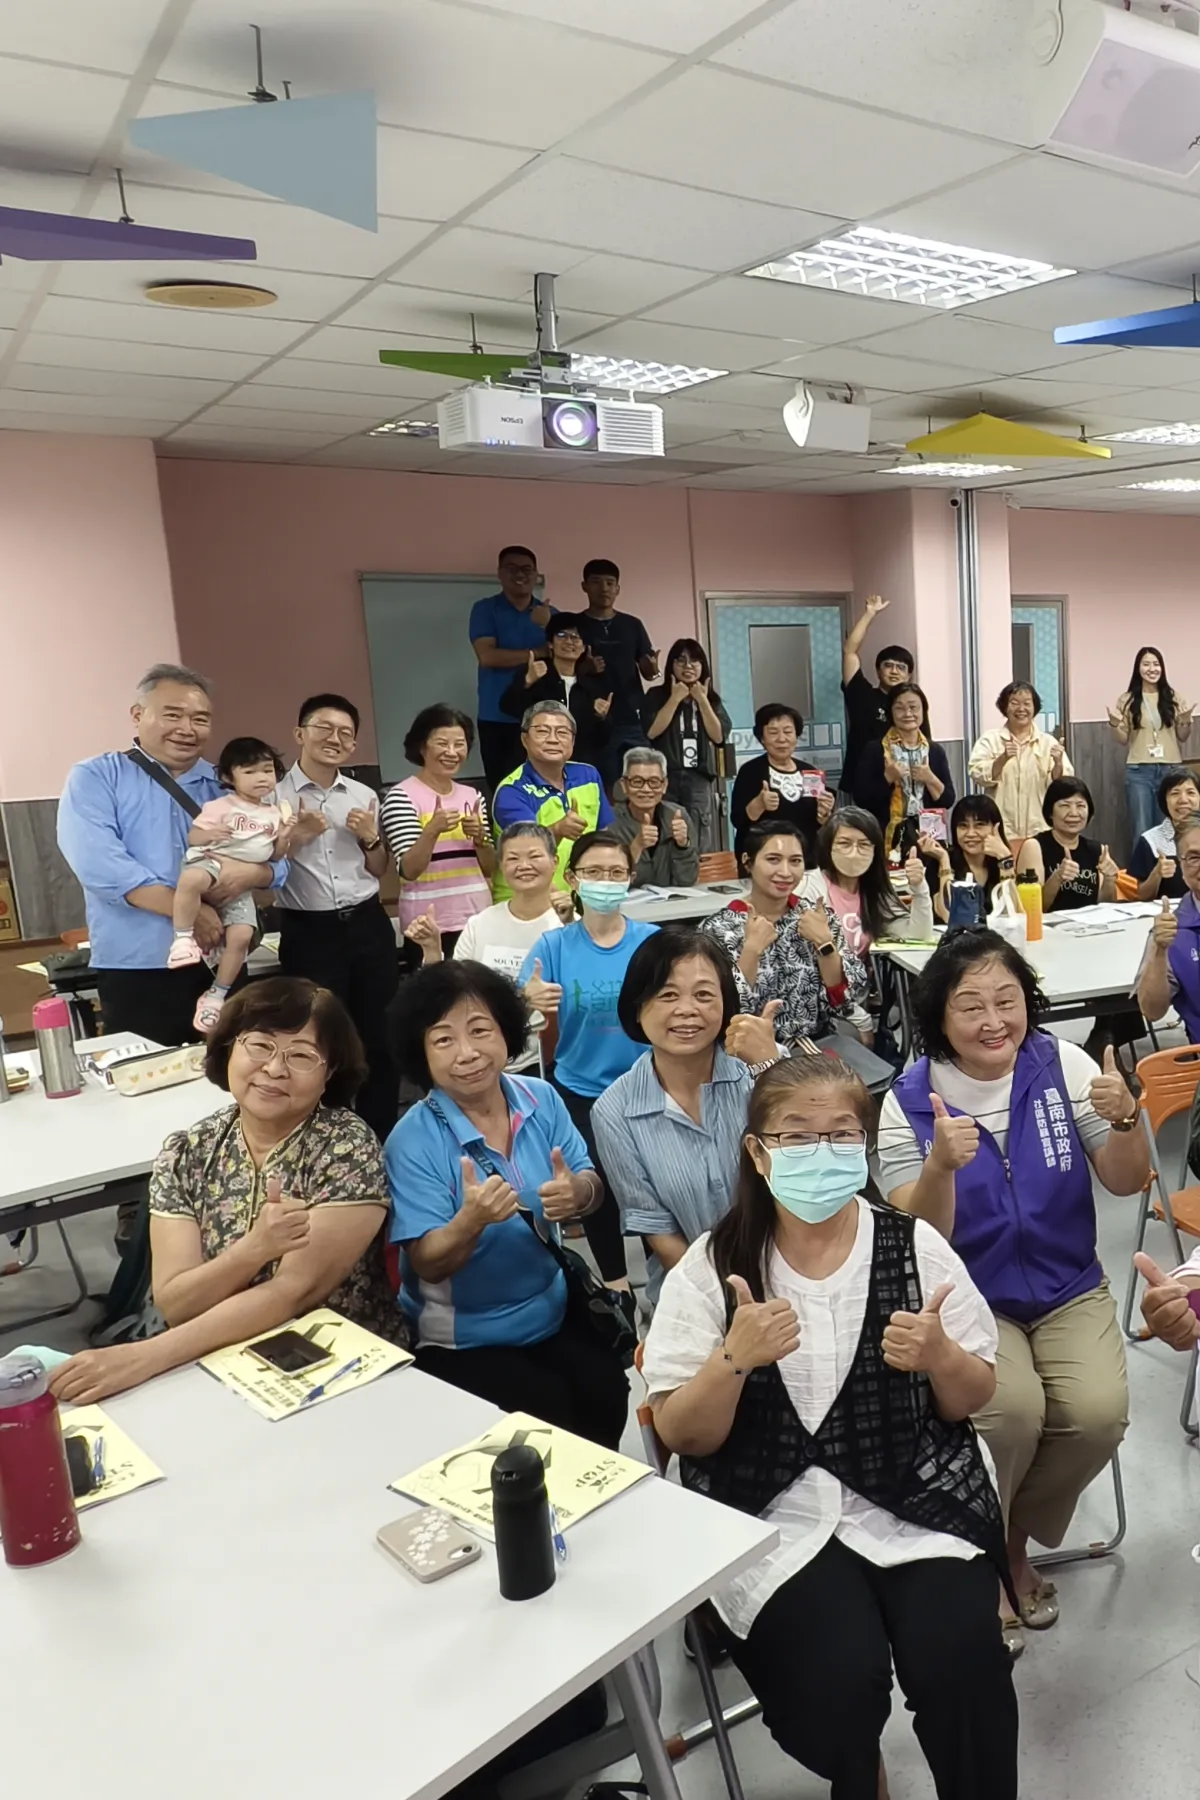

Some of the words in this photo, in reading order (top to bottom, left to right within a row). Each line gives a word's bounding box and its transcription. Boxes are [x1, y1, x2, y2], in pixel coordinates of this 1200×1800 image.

[1043, 1087, 1072, 1173] 臺南市政府
